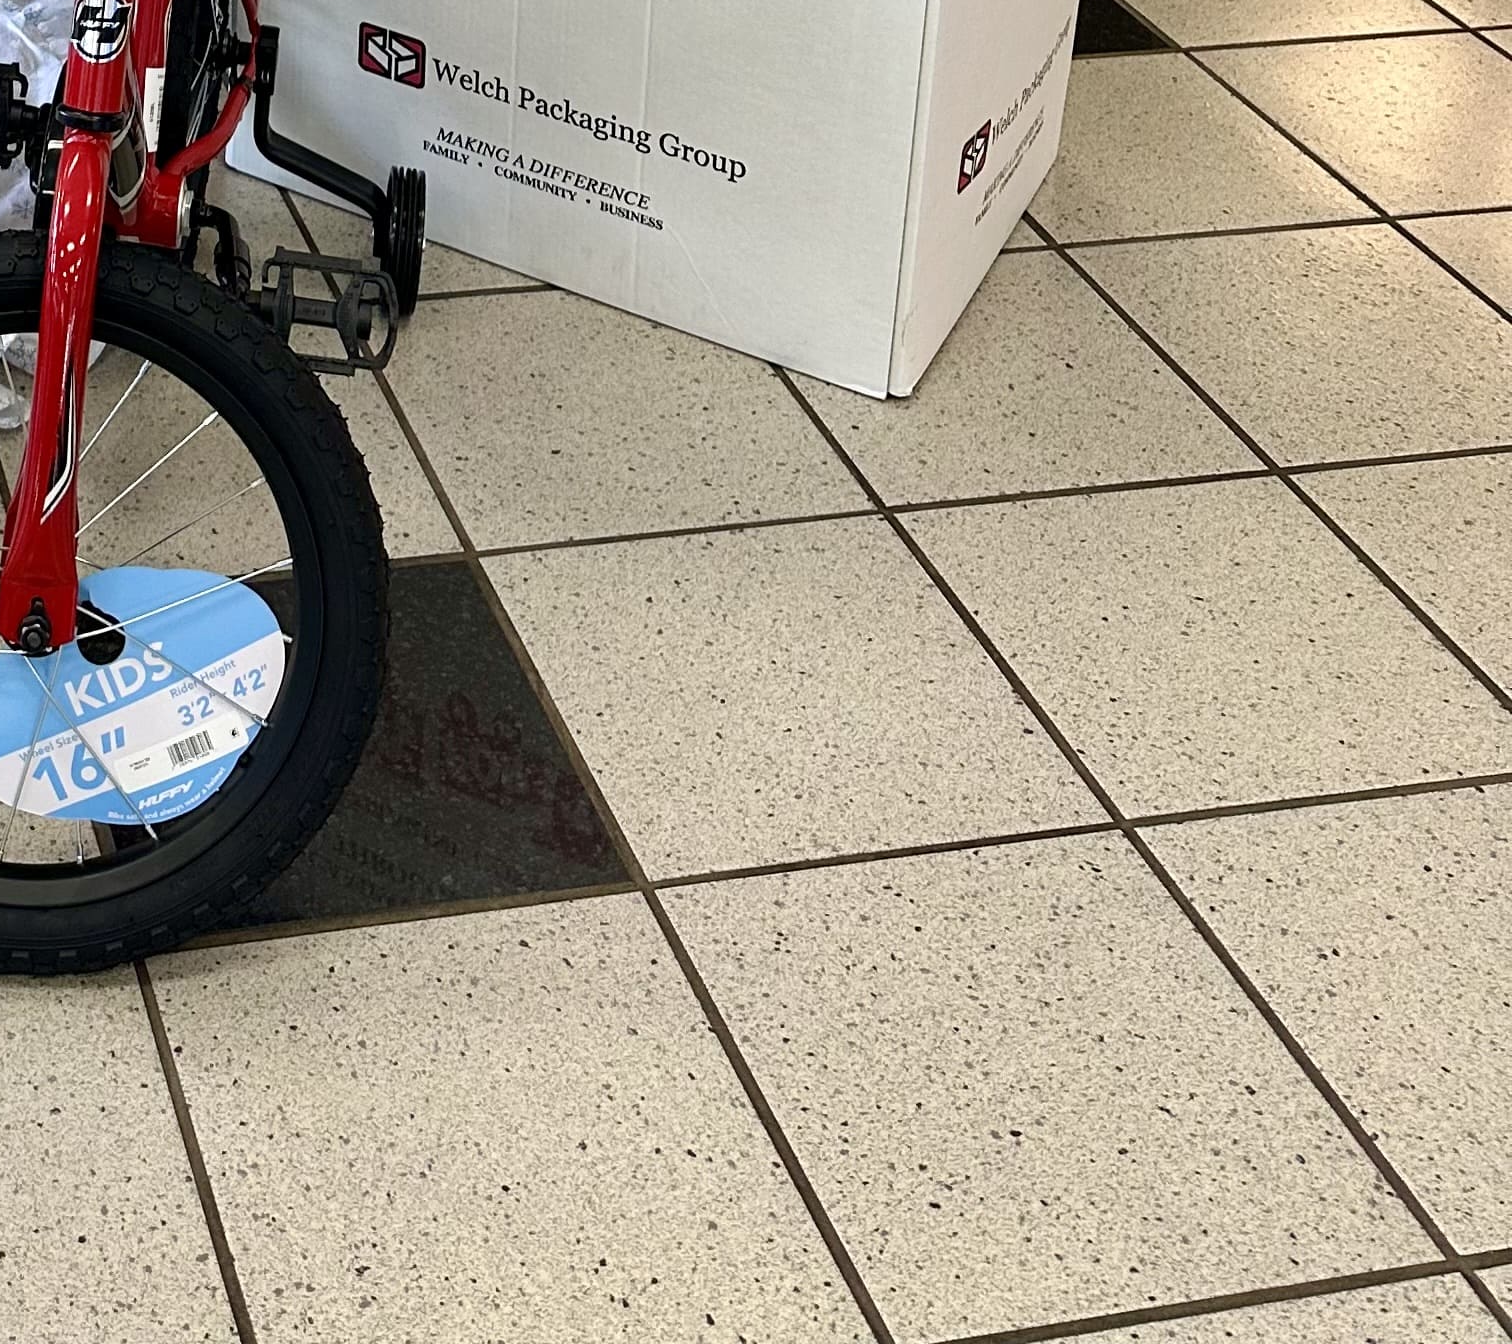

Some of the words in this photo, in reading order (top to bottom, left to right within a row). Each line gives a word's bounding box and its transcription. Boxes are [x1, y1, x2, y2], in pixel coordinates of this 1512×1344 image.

[432, 57, 510, 104] Welch
[518, 86, 651, 154] Packaging
[659, 133, 747, 184] Group
[423, 140, 470, 165] FAMILY
[494, 166, 578, 202] COMMUNITY
[600, 201, 664, 231] BUSINESS
[436, 126, 510, 163] MAKING
[512, 154, 525, 169] A
[529, 158, 651, 210] DIFFERENCE
[64, 641, 173, 717] KIDS
[171, 673, 200, 700] Rider
[200, 659, 237, 685] Height
[18, 739, 55, 762] Wheel
[56, 733, 81, 750] Size
[139, 779, 194, 810] HUFFY
